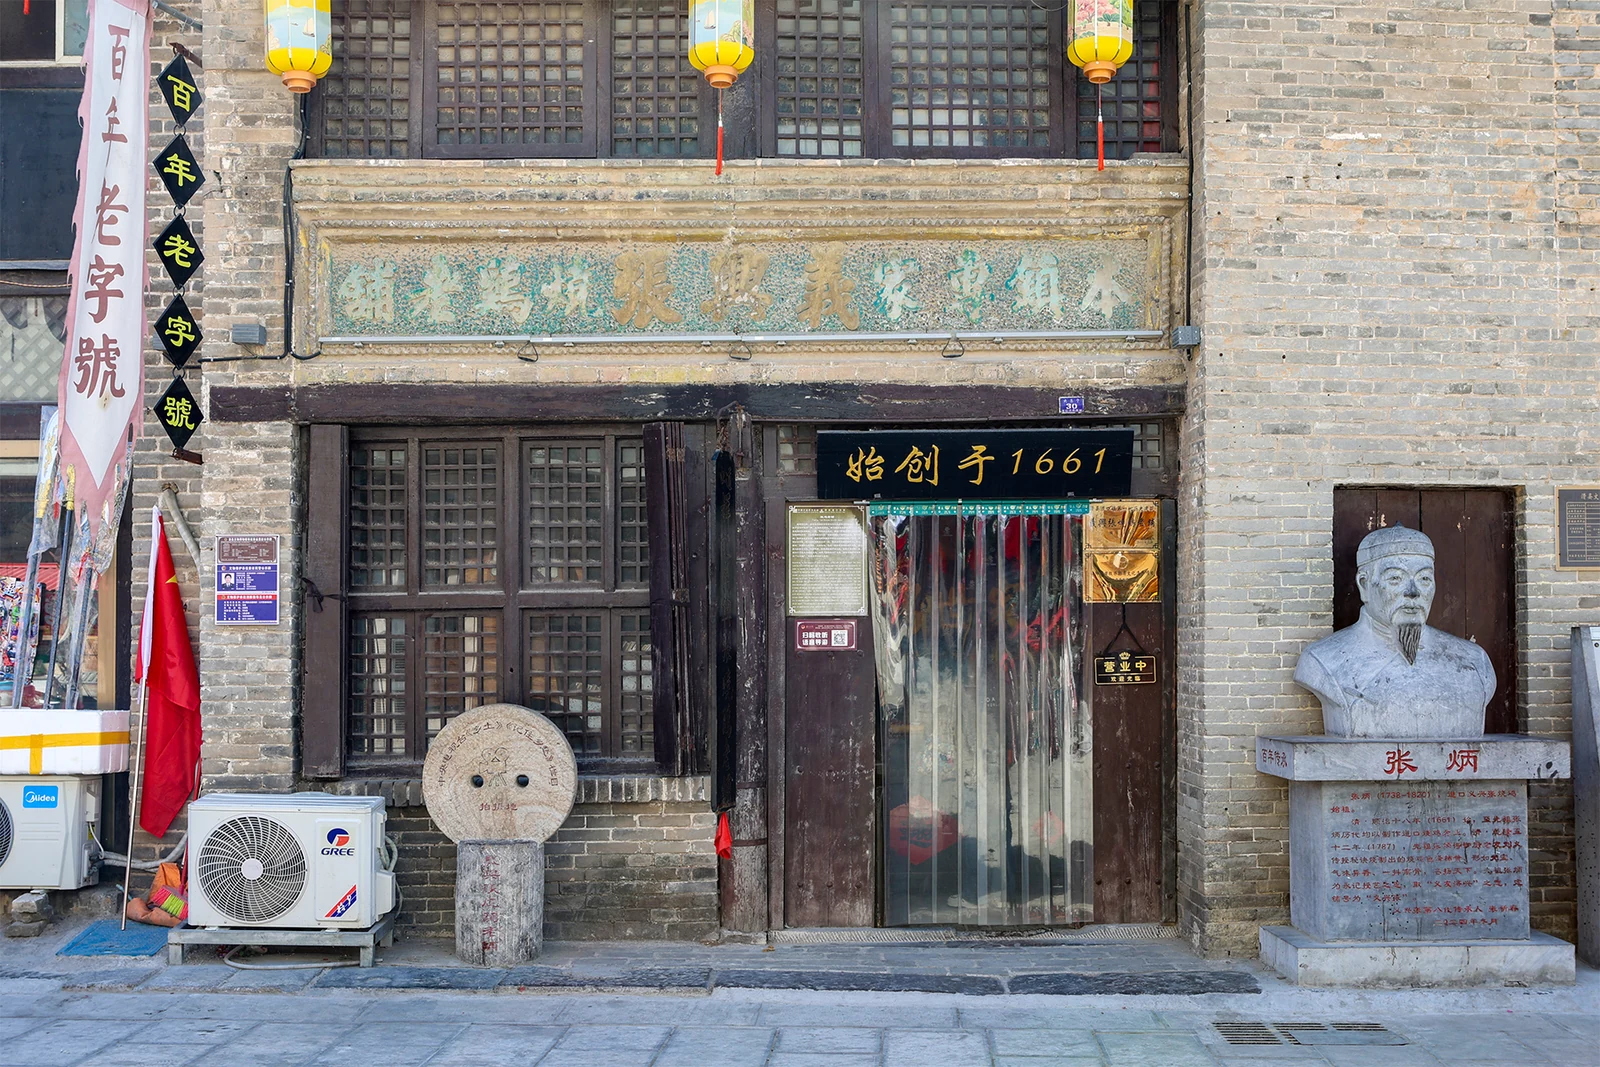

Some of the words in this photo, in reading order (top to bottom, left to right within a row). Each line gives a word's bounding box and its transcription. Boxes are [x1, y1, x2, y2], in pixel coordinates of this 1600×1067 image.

[162, 74, 197, 431] 百年老字號
[845, 443, 1108, 487] 始创于1661
[1103, 660, 1147, 673] 营业中
[1383, 749, 1480, 775] 张炳
[25, 791, 56, 804] Midea
[321, 847, 355, 856] GREE
